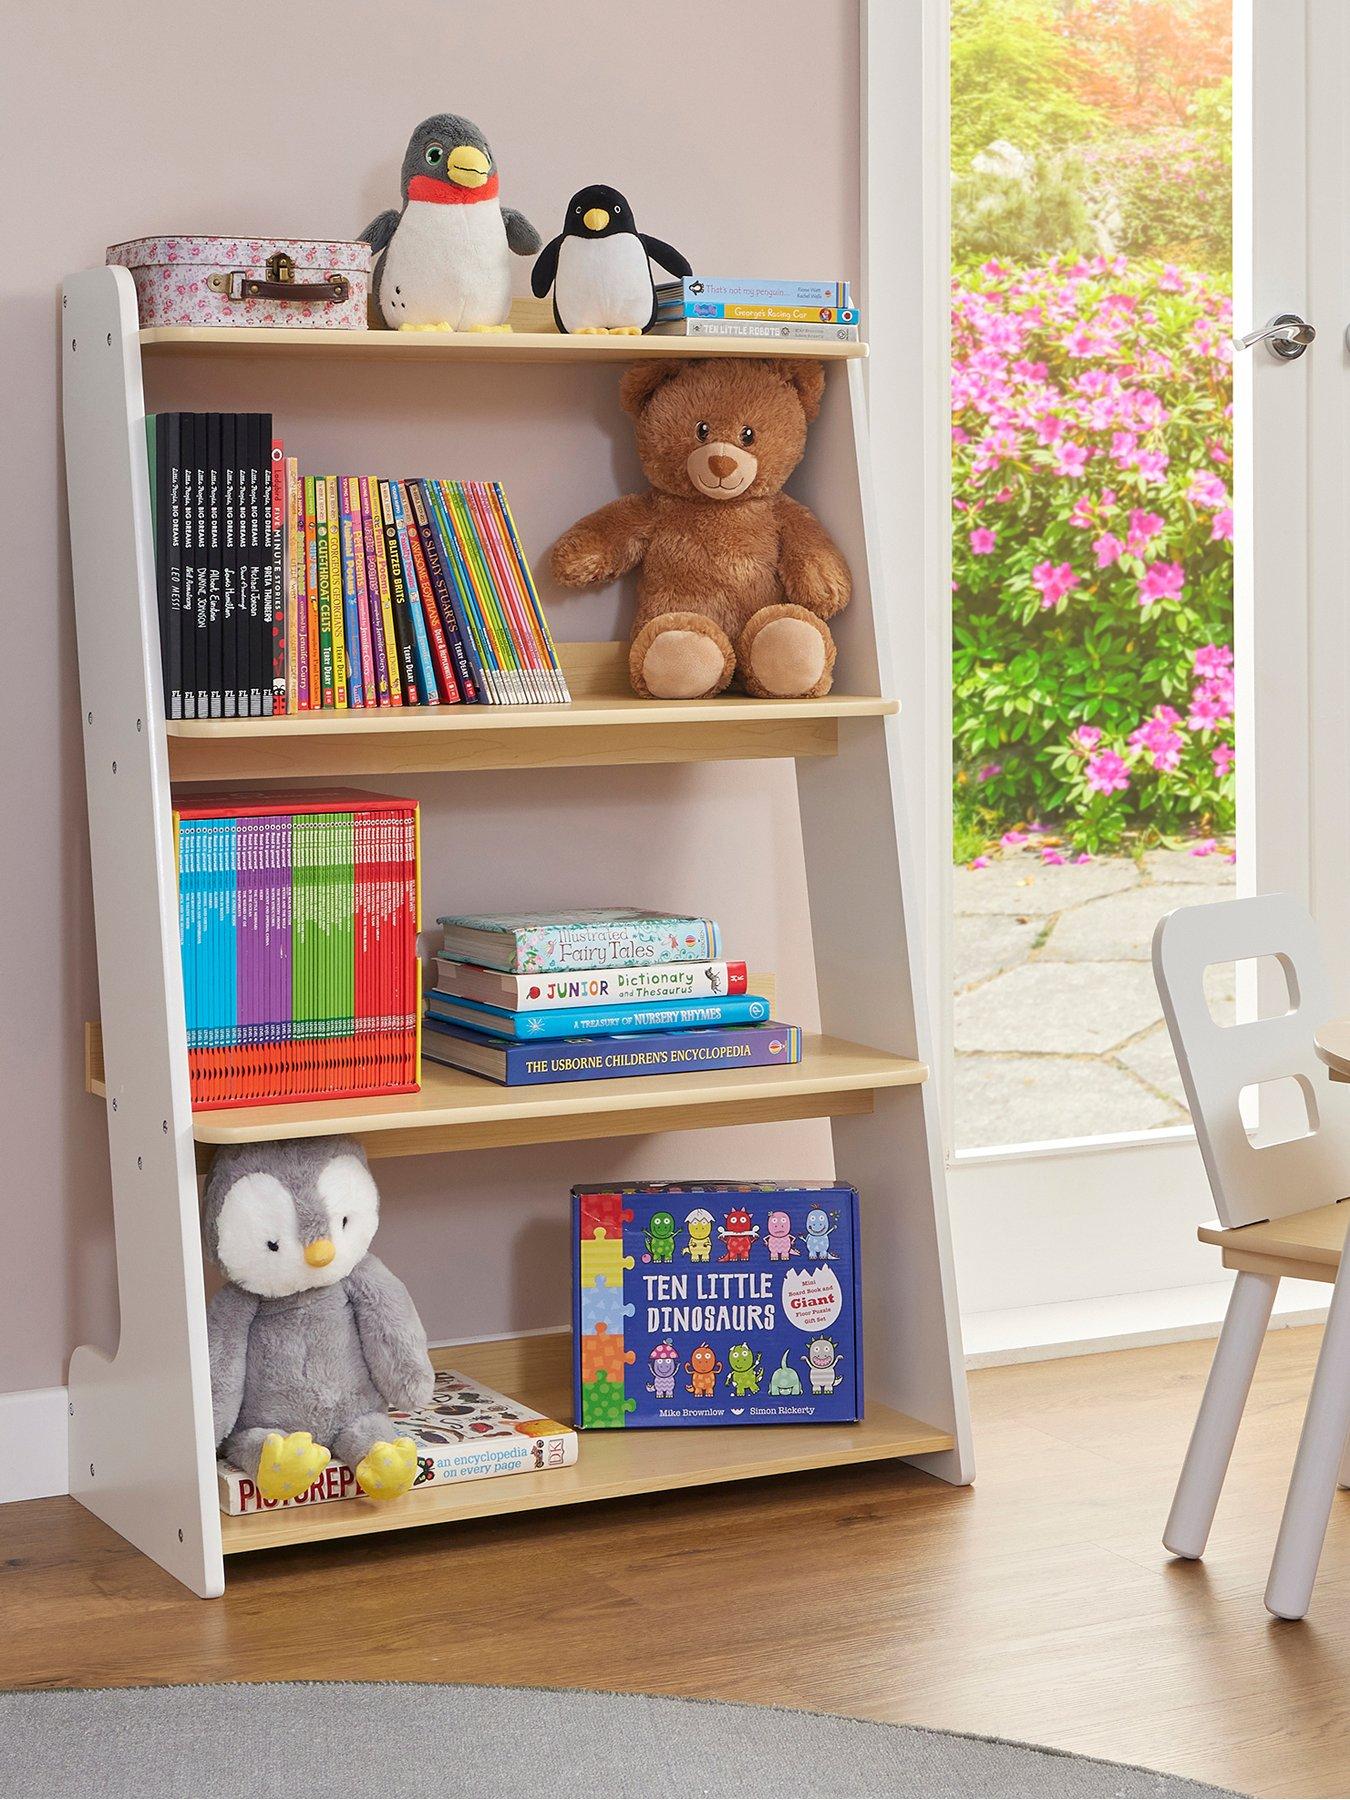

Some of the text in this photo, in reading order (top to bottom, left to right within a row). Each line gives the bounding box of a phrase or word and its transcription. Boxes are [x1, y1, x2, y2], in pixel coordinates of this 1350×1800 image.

[706, 284, 727, 294] That's
[729, 286, 742, 295] not
[743, 288, 754, 298] my
[734, 307, 807, 320] George's Racing Car
[703, 324, 780, 336] TEN LITTLE ROBOTS
[273, 470, 281, 501] Ladybird
[353, 531, 364, 587] Pet Poems
[375, 527, 385, 558] Funny
[380, 560, 389, 595] Poems
[388, 540, 405, 604] BLITZED BRITS
[264, 566, 272, 586] GRETA
[319, 540, 331, 632] CUT-THROAT CELTS
[367, 555, 378, 591] Poems
[410, 540, 428, 582] AWESOME
[420, 582, 440, 626] EGYPTIANS
[425, 540, 458, 632] SLIMY STUARTS
[171, 567, 180, 610] LEO MESSI
[197, 568, 206, 628] DWAYNE JOHNSON
[210, 570, 220, 622] Albert Einstein
[224, 568, 234, 618] Lewis Hamilton
[250, 566, 260, 616] Michael Jordan
[330, 538, 342, 637] GORGEOUS GEORGIANS
[300, 633, 308, 664] Jennifer
[360, 627, 369, 654] Jennifer
[376, 628, 385, 652] Jennifer
[434, 629, 443, 644] DEARY
[323, 647, 332, 685] TERRY DEARY
[403, 645, 414, 683] TERRY DEARY
[454, 642, 468, 678] TERRY DEARY
[300, 666, 308, 690] Curry
[559, 928, 628, 943] Illustrated
[560, 940, 654, 964] Fairy Tales
[547, 980, 608, 999] JUNIOR
[618, 972, 693, 986] Dictionary
[618, 985, 693, 998] and Thesaurus
[581, 1018, 620, 1028] TREASURY
[622, 1016, 632, 1025] OF
[634, 1010, 679, 1025] NURSERY
[681, 1008, 722, 1022] RHYMES
[526, 1045, 751, 1073] THE USBORNE CHILDREN'S ENCYCLOPEDIA
[643, 1273, 773, 1300] TEN LITTLE
[791, 1293, 835, 1309] Giant
[648, 1304, 775, 1333] DINOSAURS
[660, 1408, 724, 1417] Mike Brownlow
[750, 1405, 815, 1416] Simon Rickerty
[437, 1447, 528, 1468] an encyclopedia
[460, 1465, 491, 1476] every
[494, 1460, 521, 1472] page
